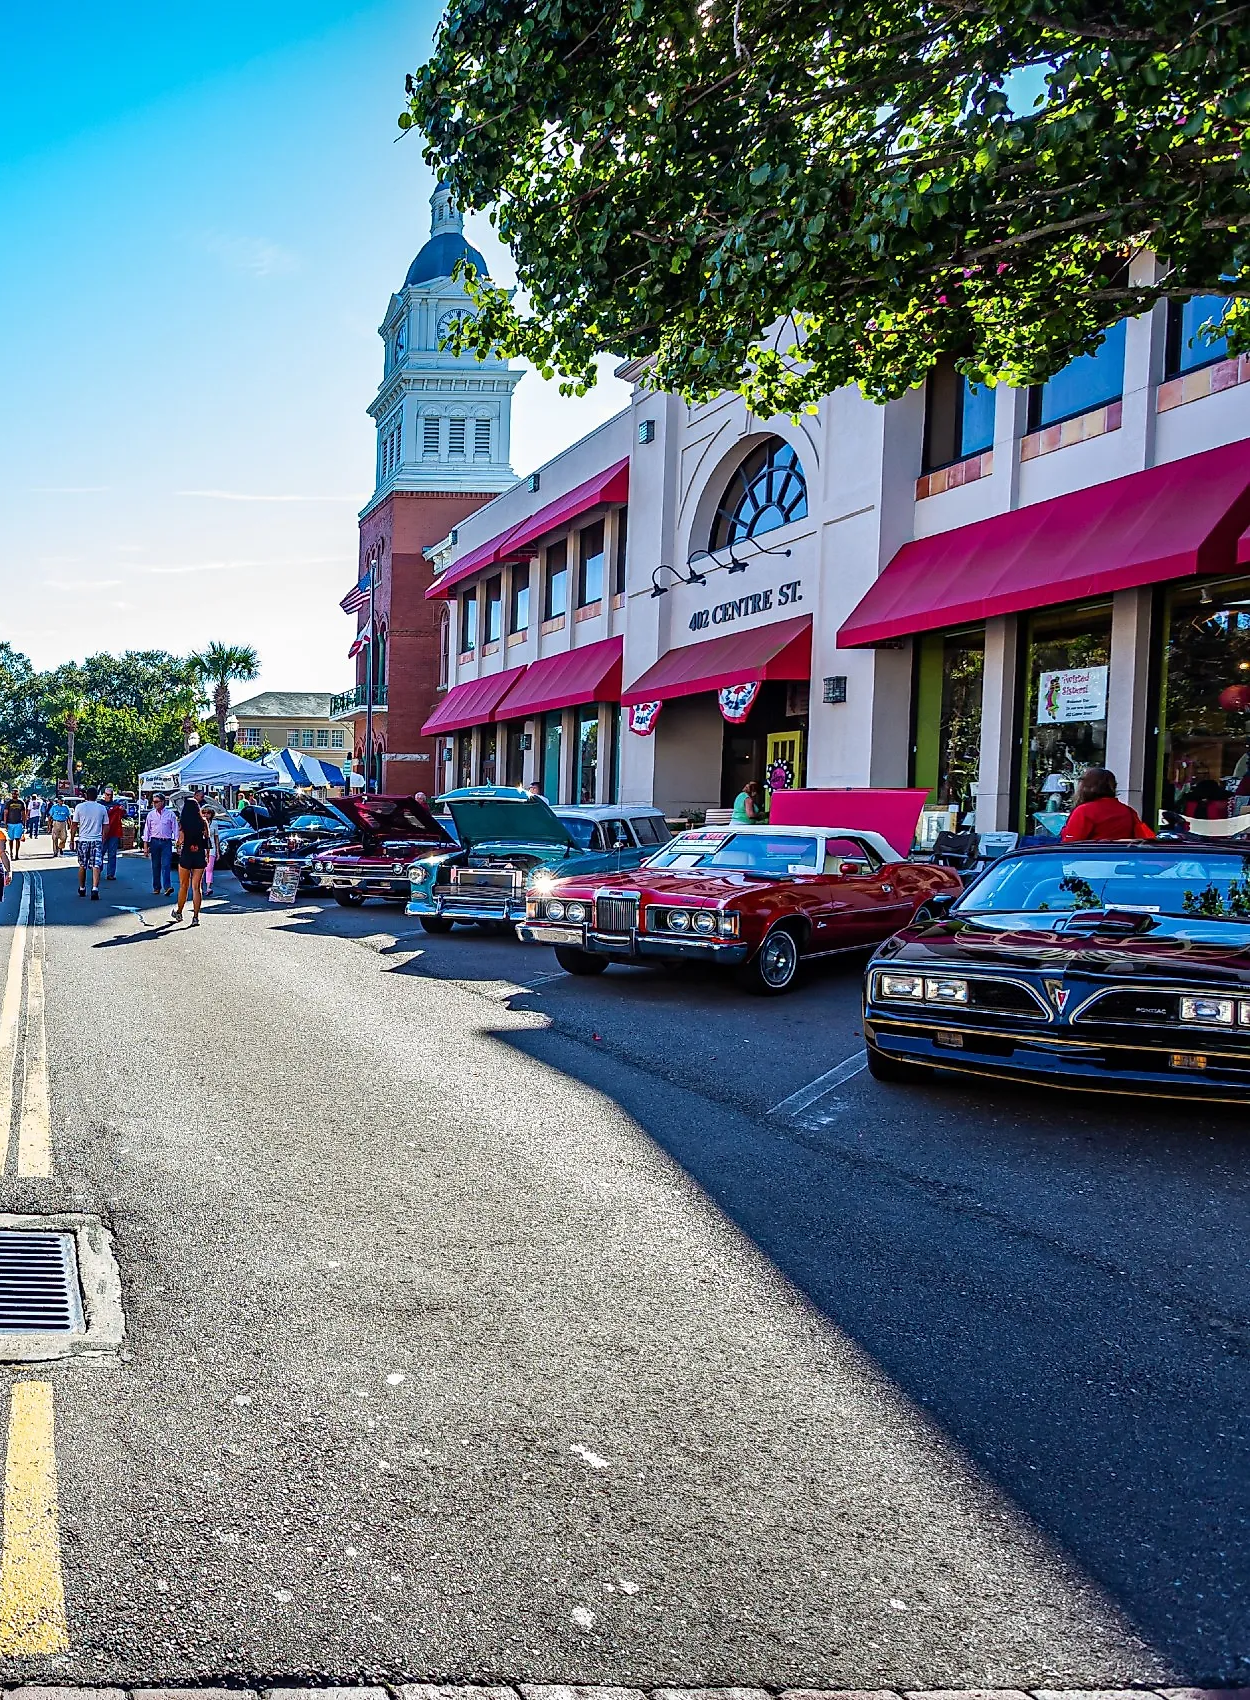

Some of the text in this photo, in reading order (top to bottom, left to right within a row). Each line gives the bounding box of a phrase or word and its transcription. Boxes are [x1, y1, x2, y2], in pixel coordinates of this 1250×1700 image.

[689, 580, 803, 631] 402 CENTRE ST.
[1135, 1007, 1167, 1015] PONTIAC
